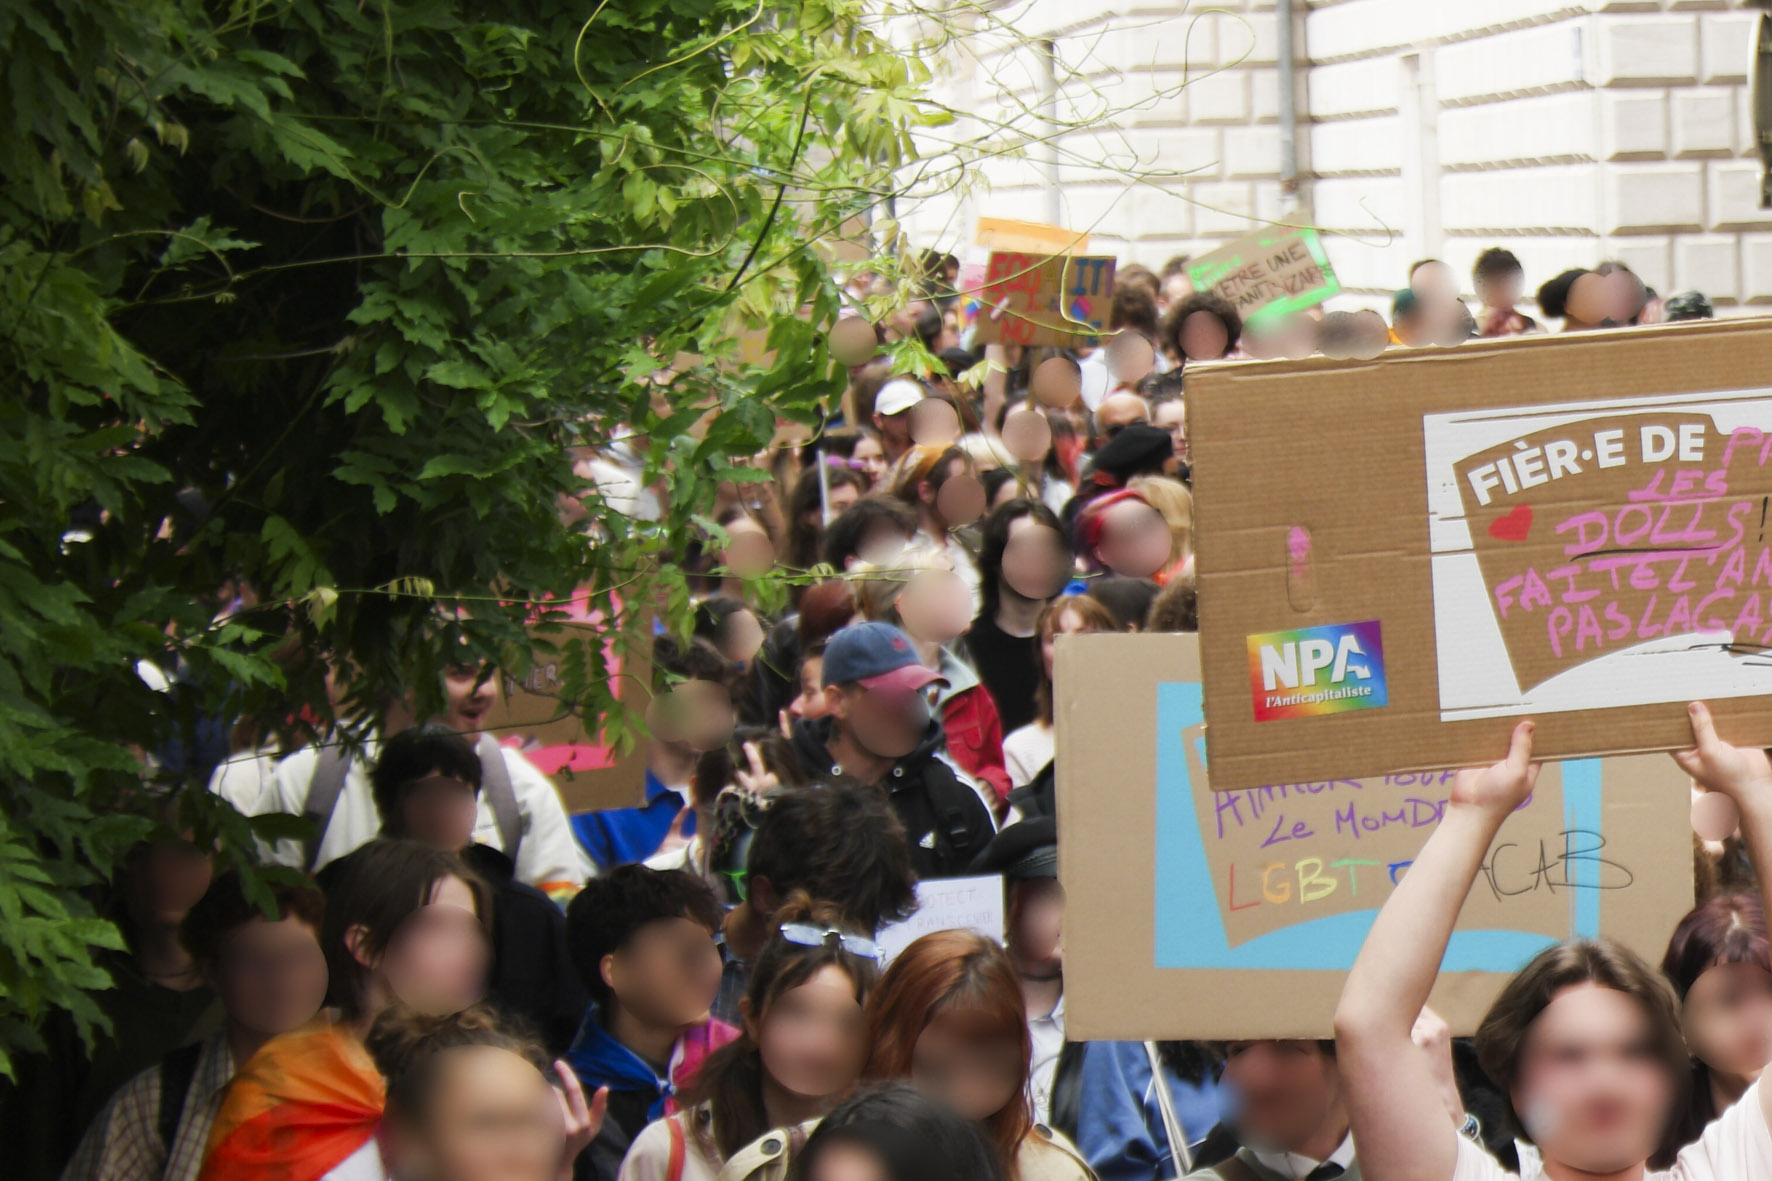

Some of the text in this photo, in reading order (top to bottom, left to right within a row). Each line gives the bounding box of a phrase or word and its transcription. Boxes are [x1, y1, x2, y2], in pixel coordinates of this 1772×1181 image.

[1640, 424, 1705, 464] DE
[1627, 468, 1729, 502] LES
[1260, 633, 1372, 692] NPA
[1260, 813, 1315, 849] Le
